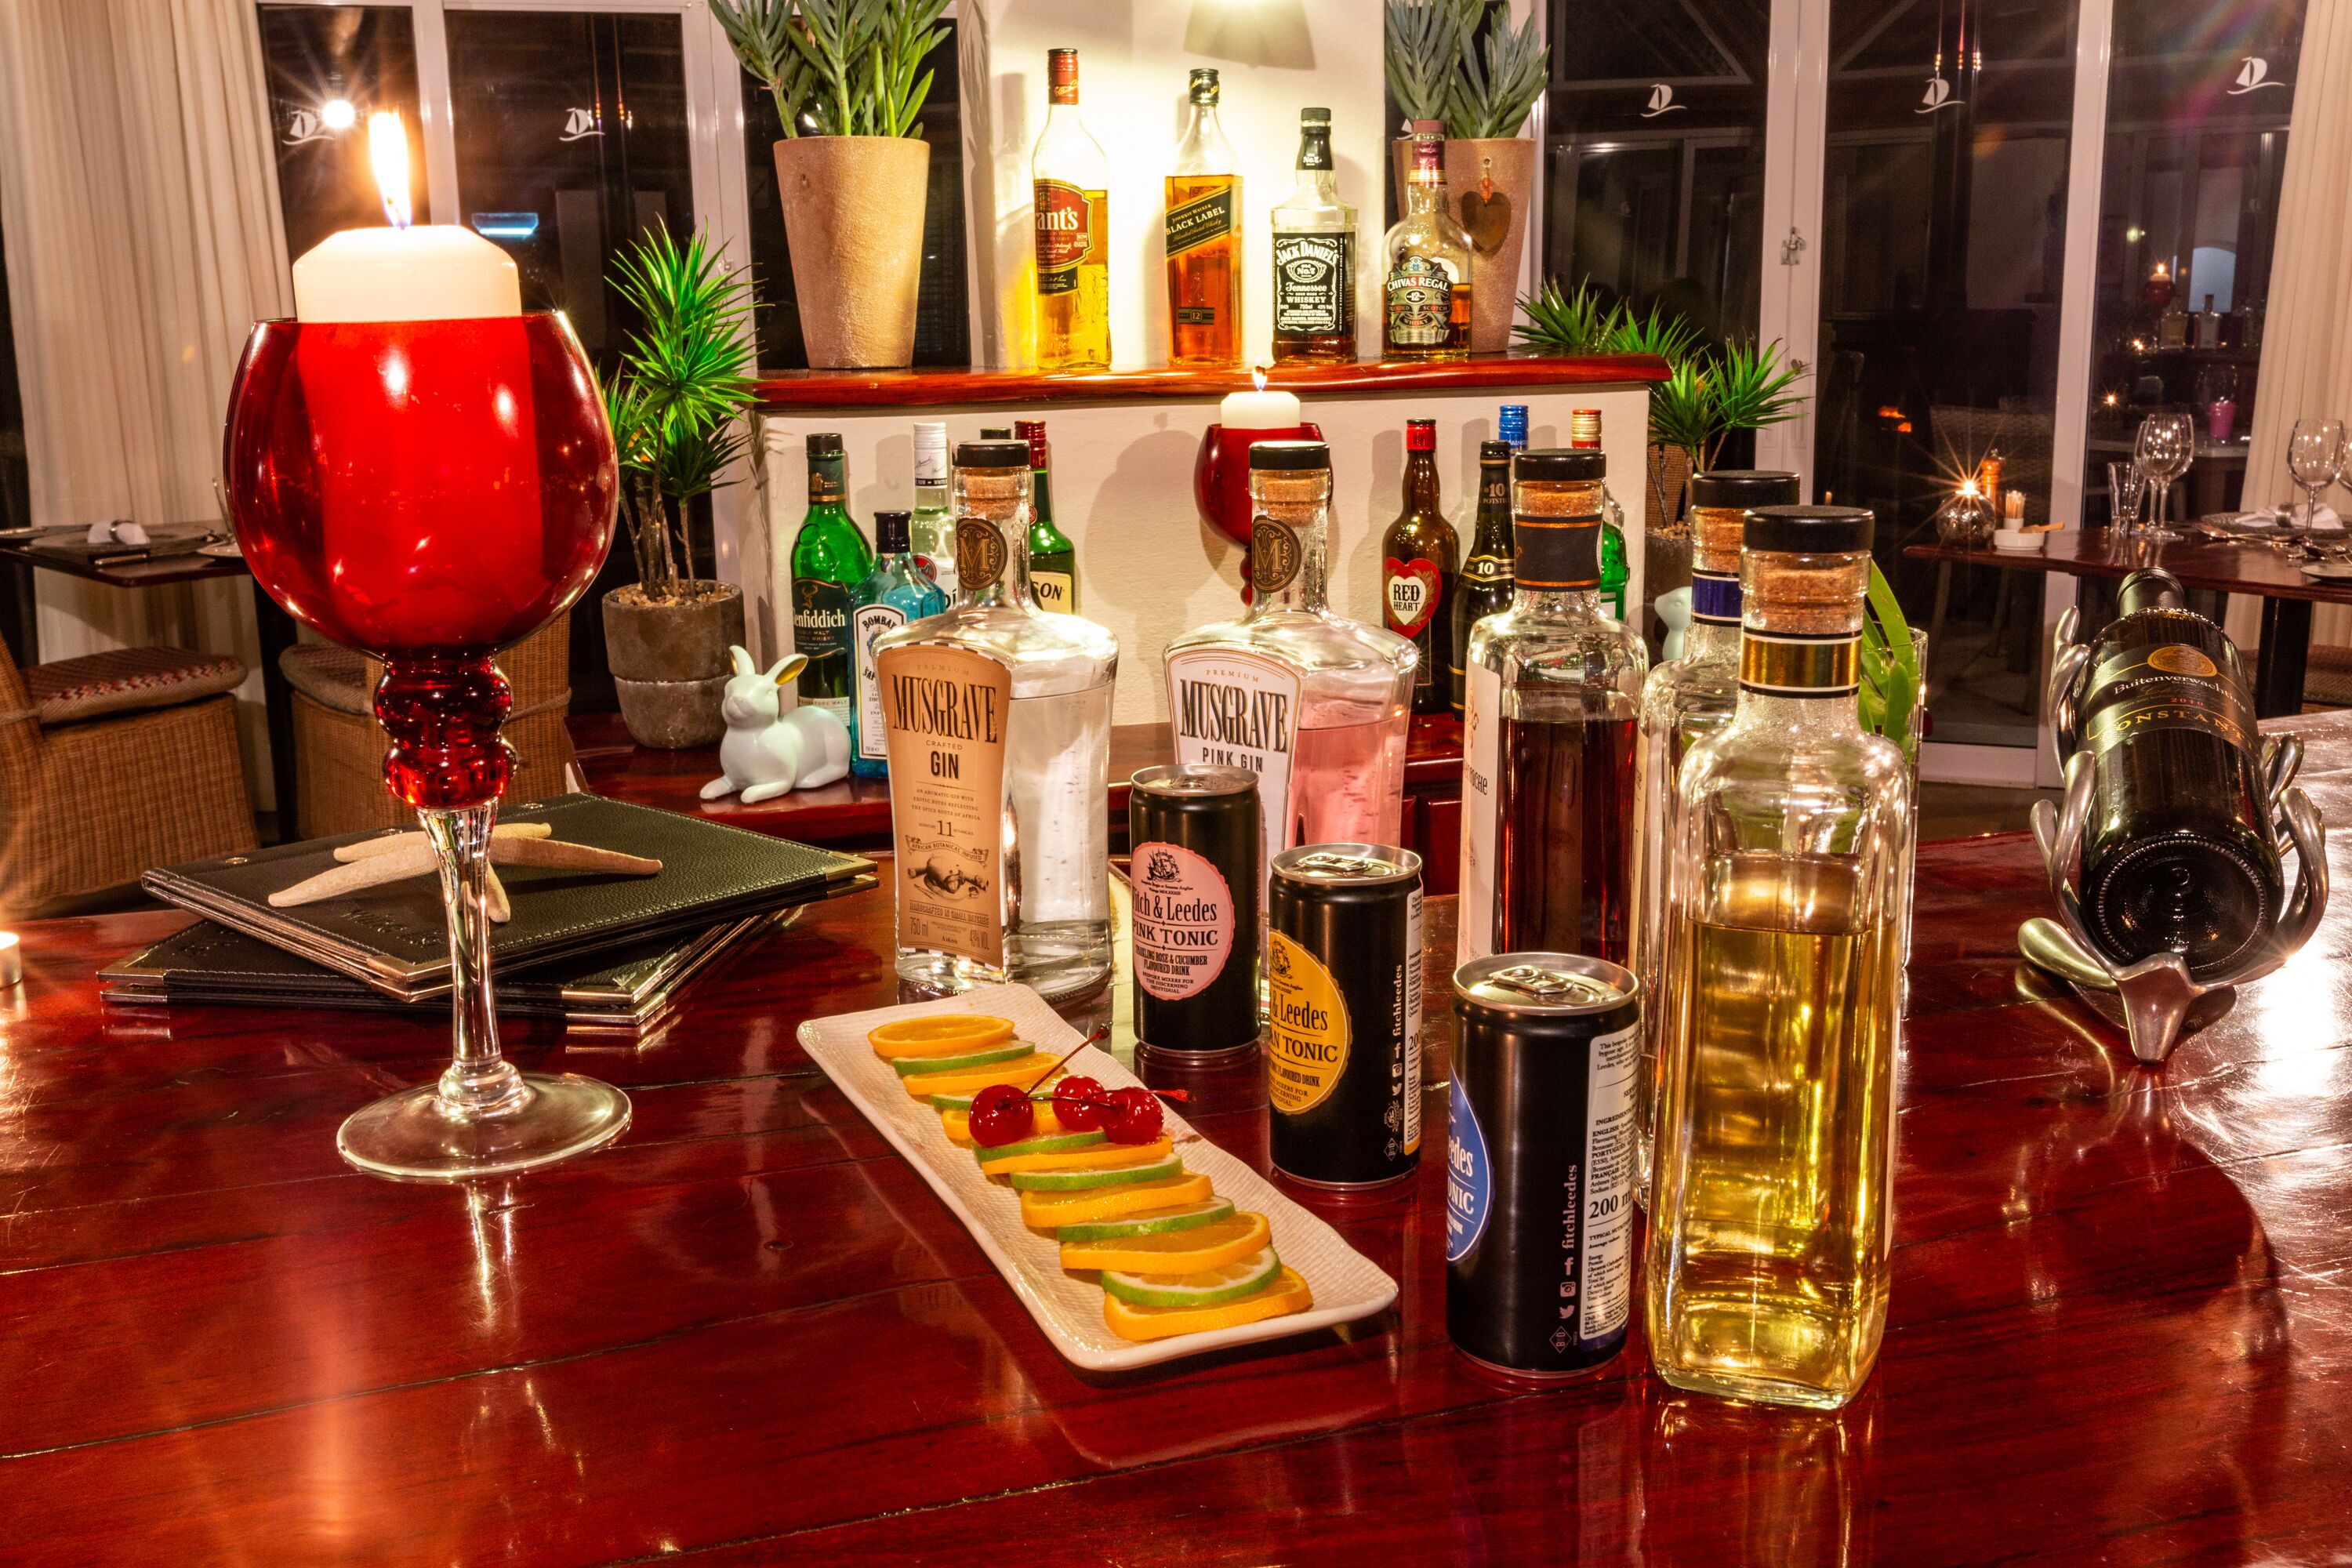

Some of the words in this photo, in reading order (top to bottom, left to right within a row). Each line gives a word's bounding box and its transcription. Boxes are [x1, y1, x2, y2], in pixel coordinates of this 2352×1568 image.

[1192, 204, 1211, 214] WALKER
[1166, 218, 1194, 235] BLACK
[1195, 206, 1225, 223] LABEL
[1276, 245, 1301, 266] JACK
[1286, 282, 1327, 292] Tennessee
[1387, 277, 1417, 292] CHIVAS
[1417, 277, 1449, 292] REGAL
[1410, 292, 1420, 301] 12
[1489, 483, 1505, 497] 10
[1477, 562, 1495, 575] 10
[1393, 584, 1421, 601] RED
[1393, 601, 1420, 612] HEART
[916, 664, 970, 677] PREMIUM
[1206, 670, 1259, 683] PREMIUM
[2114, 676, 2247, 714] Buitenverwachting
[891, 674, 997, 744] MUSGRAVE
[1180, 678, 1288, 753] MUSGRAVE
[926, 740, 963, 751] CRAFTED
[931, 750, 959, 779] GIN
[1203, 747, 1234, 767] PINK
[1240, 753, 1263, 773] GIN
[924, 789, 949, 798] AROMATIC
[948, 802, 978, 811] REFLECTING
[937, 820, 956, 838] 11
[932, 842, 961, 853] BOTANICAL
[961, 851, 982, 861] INFUSED
[1153, 895, 1163, 919] &
[1167, 897, 1217, 922] Leedes
[909, 916, 920, 935] 750
[1132, 917, 1156, 942] PINK
[1160, 928, 1218, 946] TONIC
[1144, 959, 1171, 974] FLAVOURED
[1171, 964, 1190, 976] DRINK
[1174, 955, 1208, 966] CUCUMBER
[1142, 971, 1160, 980] BESPOKE
[1150, 984, 1181, 994] INDIVIDUAL
[1156, 980, 1189, 989] DISCERNING
[1392, 964, 1403, 1036] fitchleedes
[1272, 990, 1279, 1018] &
[1280, 993, 1329, 1031] Leedes
[1283, 1035, 1338, 1063] TONIC
[1599, 1049, 1616, 1058] bygone
[1278, 1065, 1301, 1084] FLAVOURED
[1302, 1073, 1321, 1087] DRINK
[1295, 1087, 1308, 1098] FOR
[1562, 1164, 1577, 1249] fitchleedes
[1588, 1194, 1618, 1219] 200
[1588, 1230, 1610, 1241] TYPICAL
